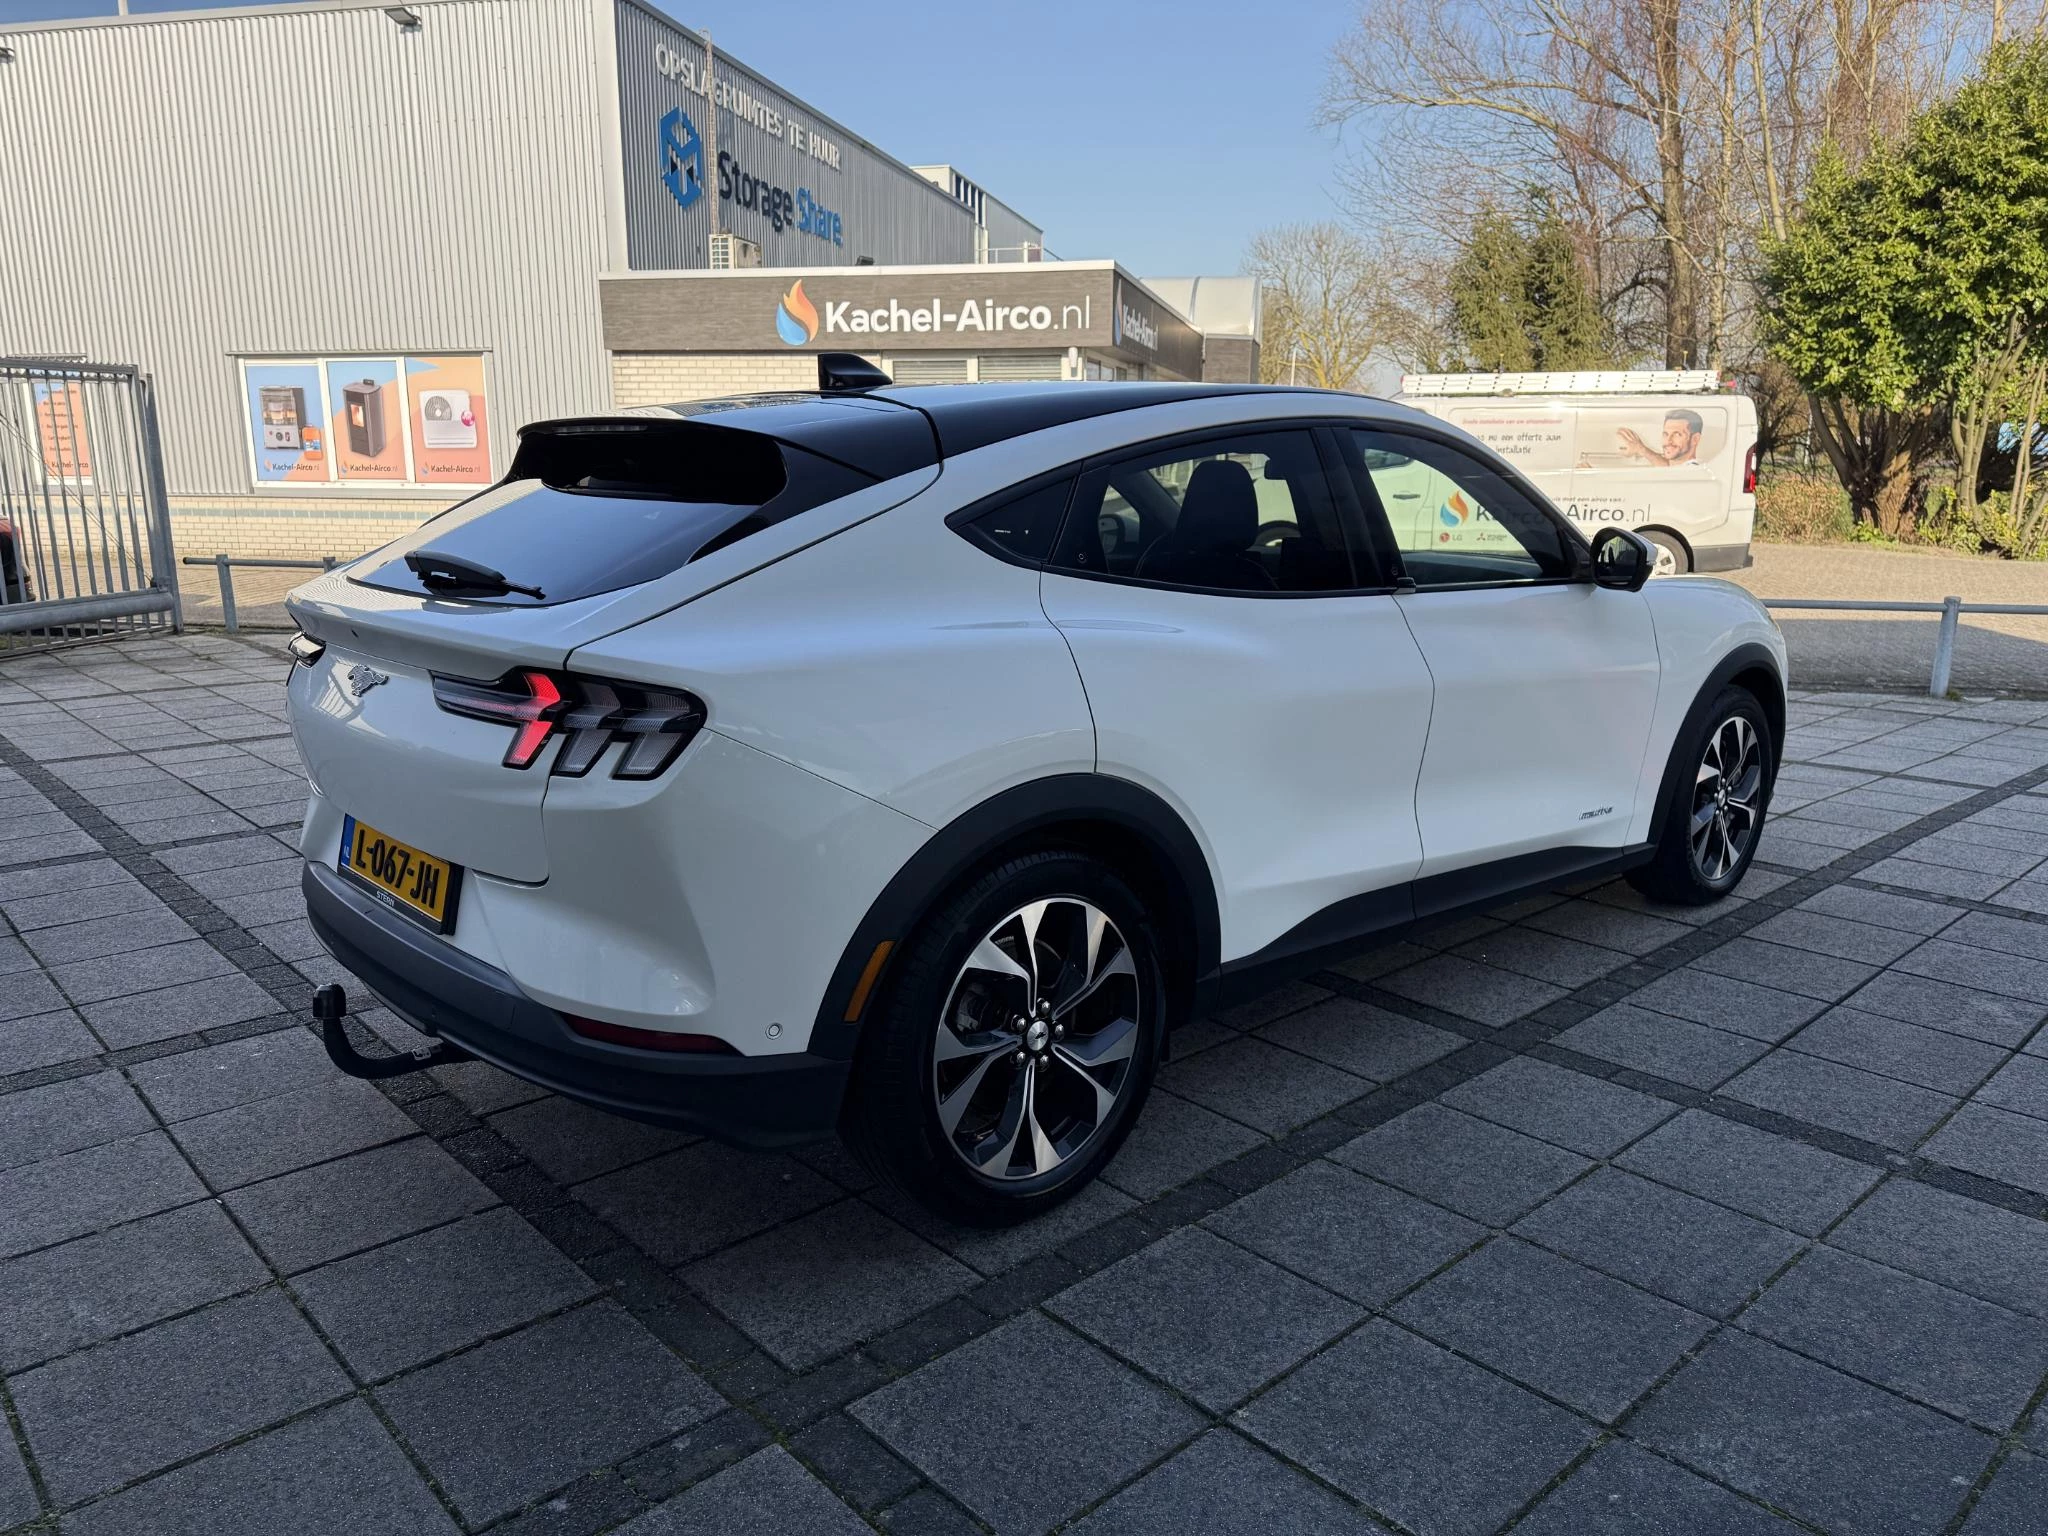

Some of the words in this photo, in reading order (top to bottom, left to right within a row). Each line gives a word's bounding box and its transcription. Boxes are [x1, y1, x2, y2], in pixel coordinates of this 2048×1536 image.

[656, 43, 783, 138] OPSLAGRUIMTES
[788, 119, 806, 151] TE
[809, 131, 841, 171] HUUR
[718, 151, 793, 233] Storage
[796, 187, 843, 246] Share
[825, 295, 1091, 333] Kachel-Airco.nl
[1517, 432, 1543, 442] offerte
[356, 829, 440, 909] L-067-JH
[376, 890, 395, 907] STERN
